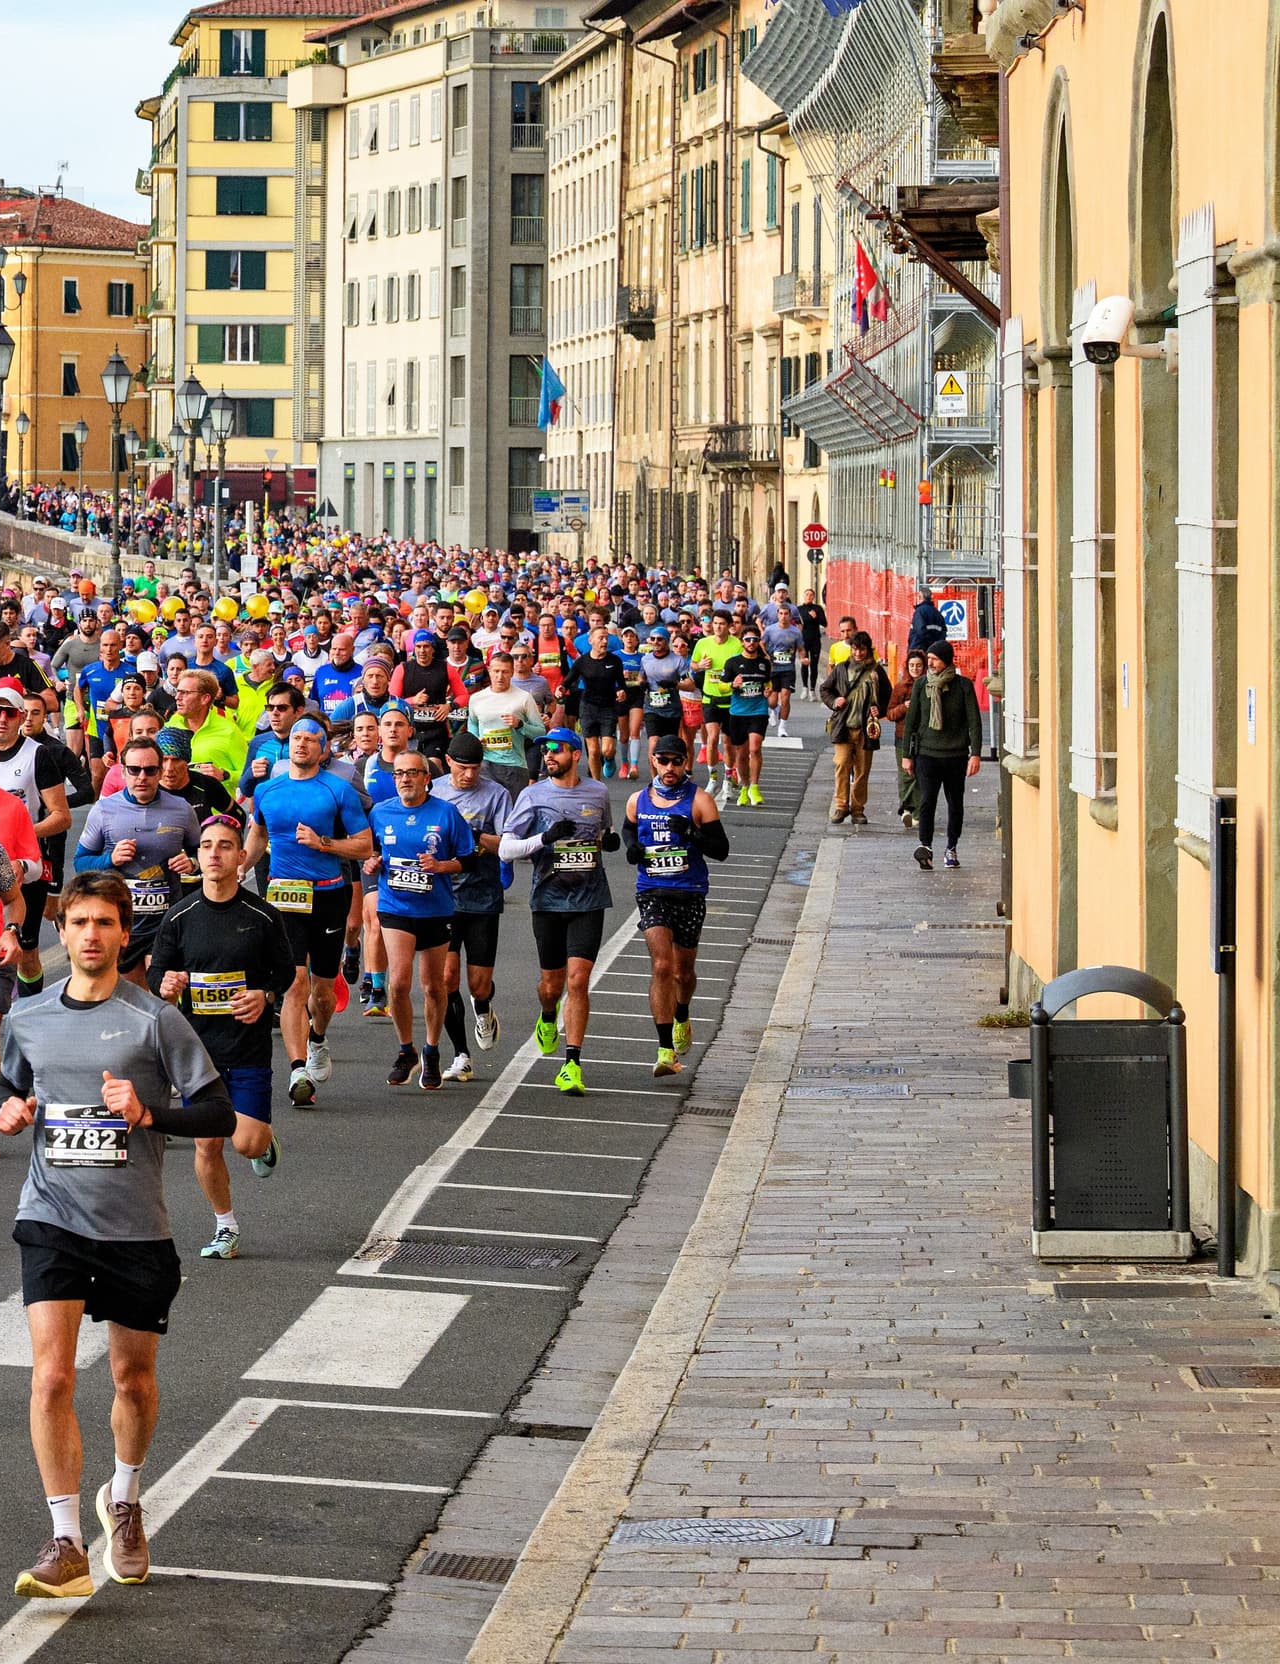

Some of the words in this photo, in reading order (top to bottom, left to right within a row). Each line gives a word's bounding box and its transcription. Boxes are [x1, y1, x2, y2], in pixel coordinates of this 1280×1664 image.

[802, 531, 827, 542] STOP
[558, 851, 595, 863] 3530
[649, 856, 684, 868] 3119
[393, 870, 429, 884] 2683
[272, 891, 308, 904] 1008
[51, 1127, 118, 1150] 2782
